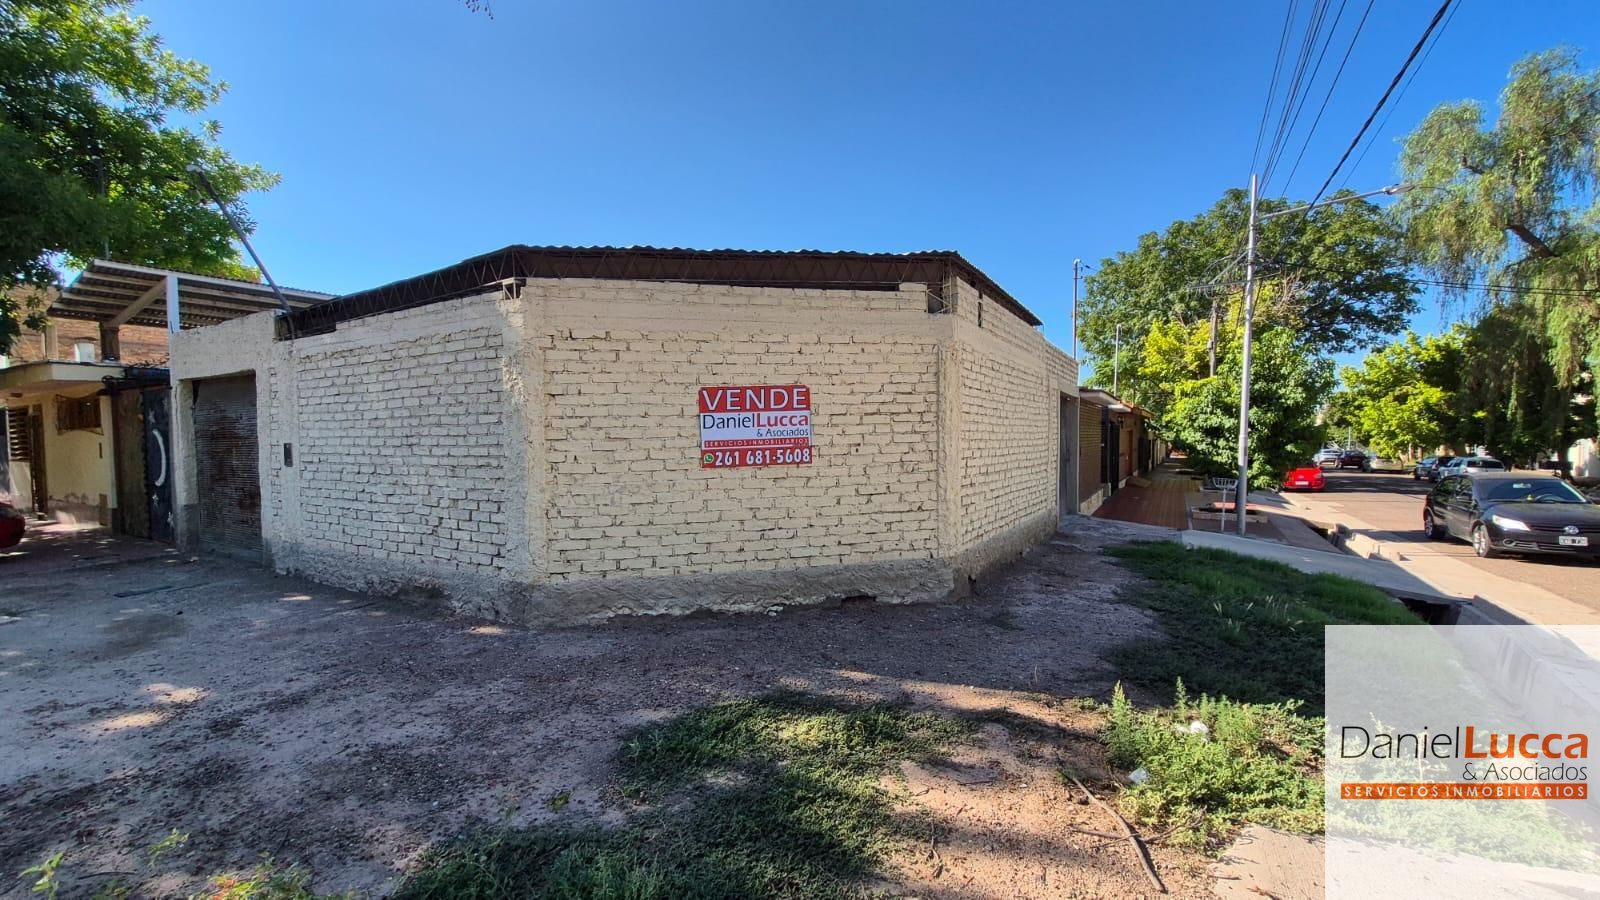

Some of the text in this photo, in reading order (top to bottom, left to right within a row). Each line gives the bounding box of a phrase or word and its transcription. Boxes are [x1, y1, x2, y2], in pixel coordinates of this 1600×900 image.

[702, 388, 807, 411] VENDE
[765, 428, 809, 437] Asociados
[749, 438, 808, 446] INMOBILIARIOS
[715, 451, 740, 466] 261
